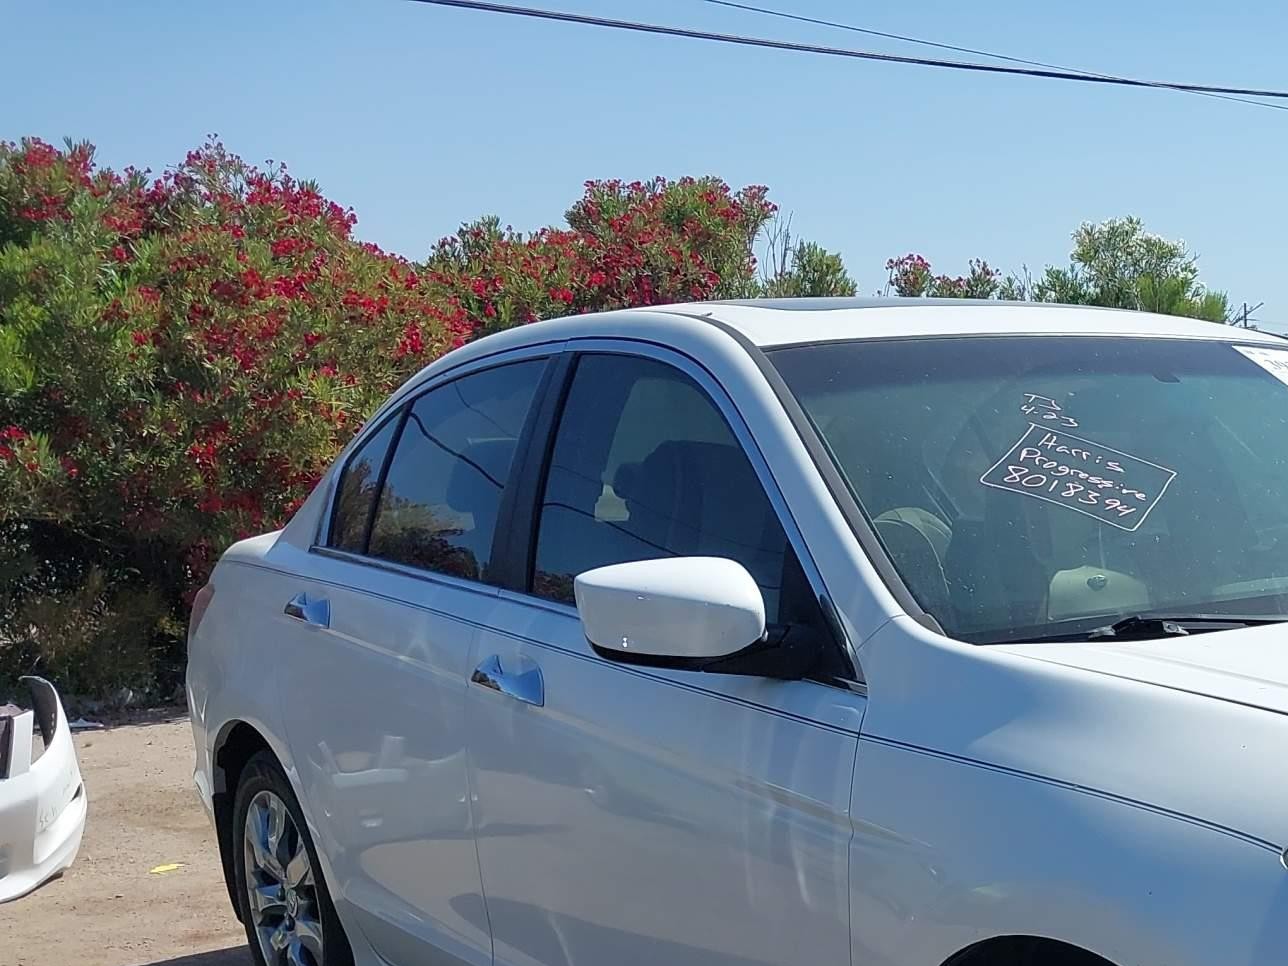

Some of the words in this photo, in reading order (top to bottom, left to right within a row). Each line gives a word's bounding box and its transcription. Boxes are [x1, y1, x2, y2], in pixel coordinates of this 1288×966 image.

[1019, 447, 1147, 502] Progressive
[1038, 433, 1125, 472] Harris
[1003, 465, 1137, 517] 8018394
